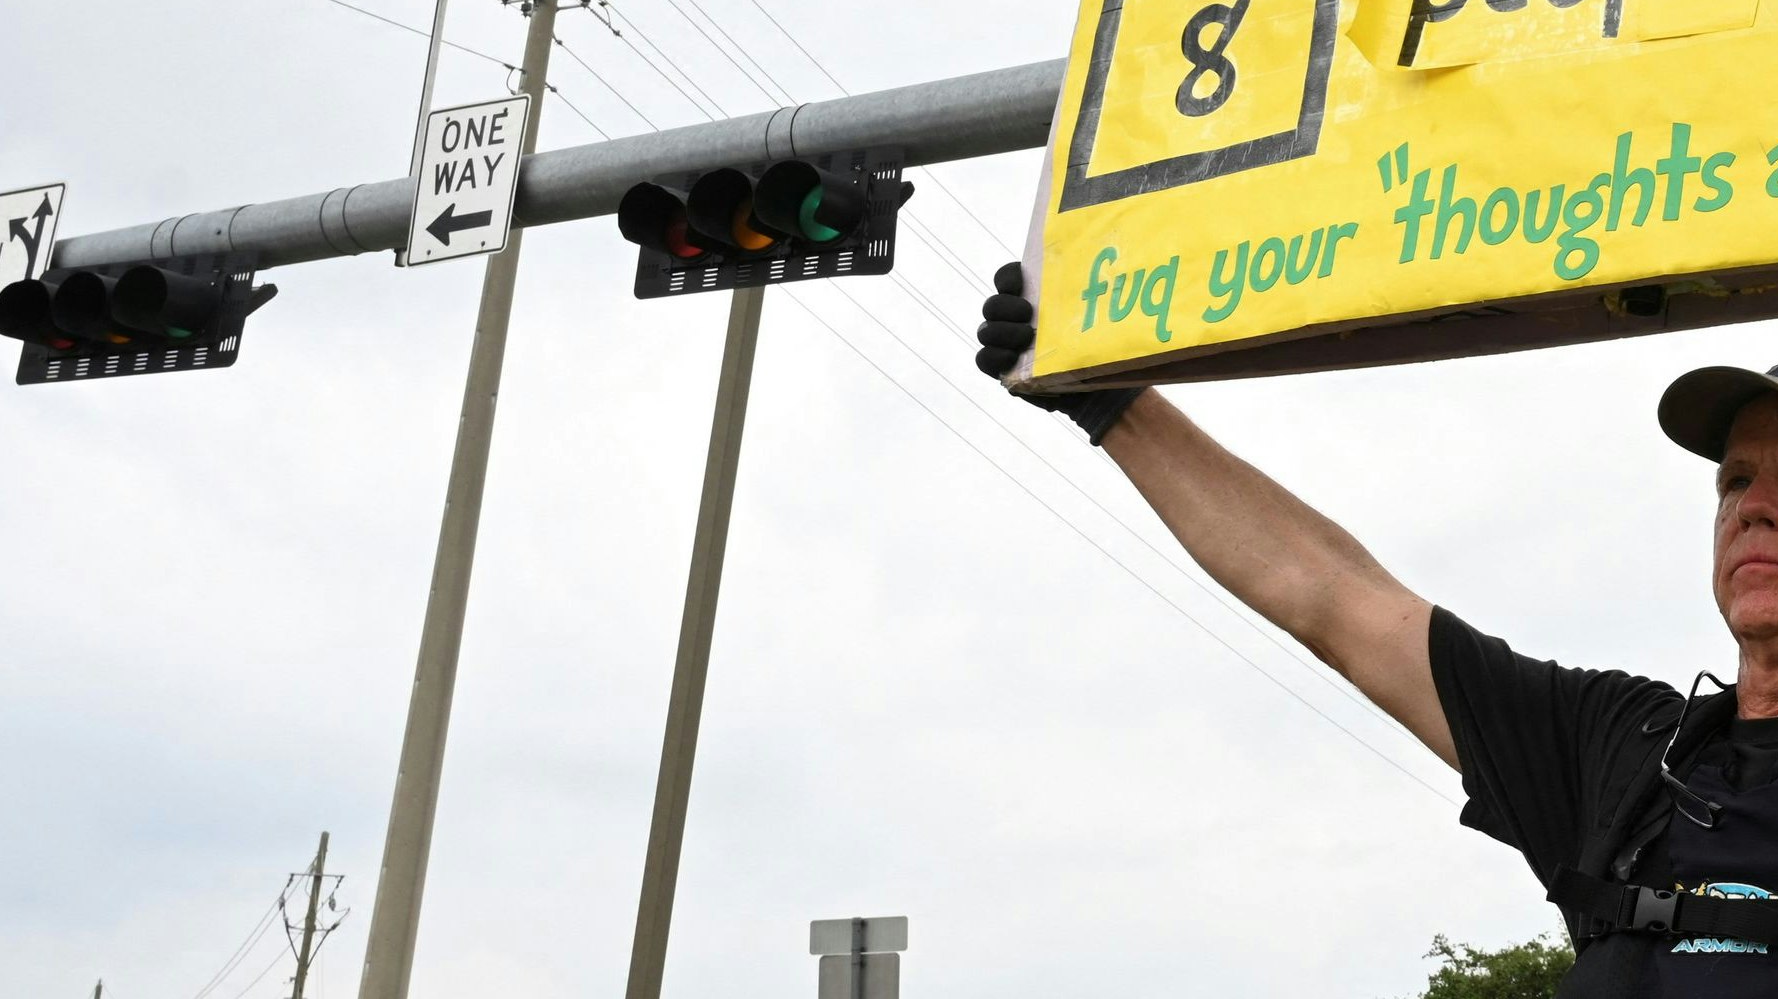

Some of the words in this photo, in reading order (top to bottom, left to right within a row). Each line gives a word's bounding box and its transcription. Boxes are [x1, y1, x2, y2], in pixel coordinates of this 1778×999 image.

[441, 112, 509, 154] ONE
[434, 152, 506, 196] WAY
[1080, 245, 1177, 342] fuq
[1201, 221, 1359, 324] your
[1671, 937, 1768, 955] ARMOR
